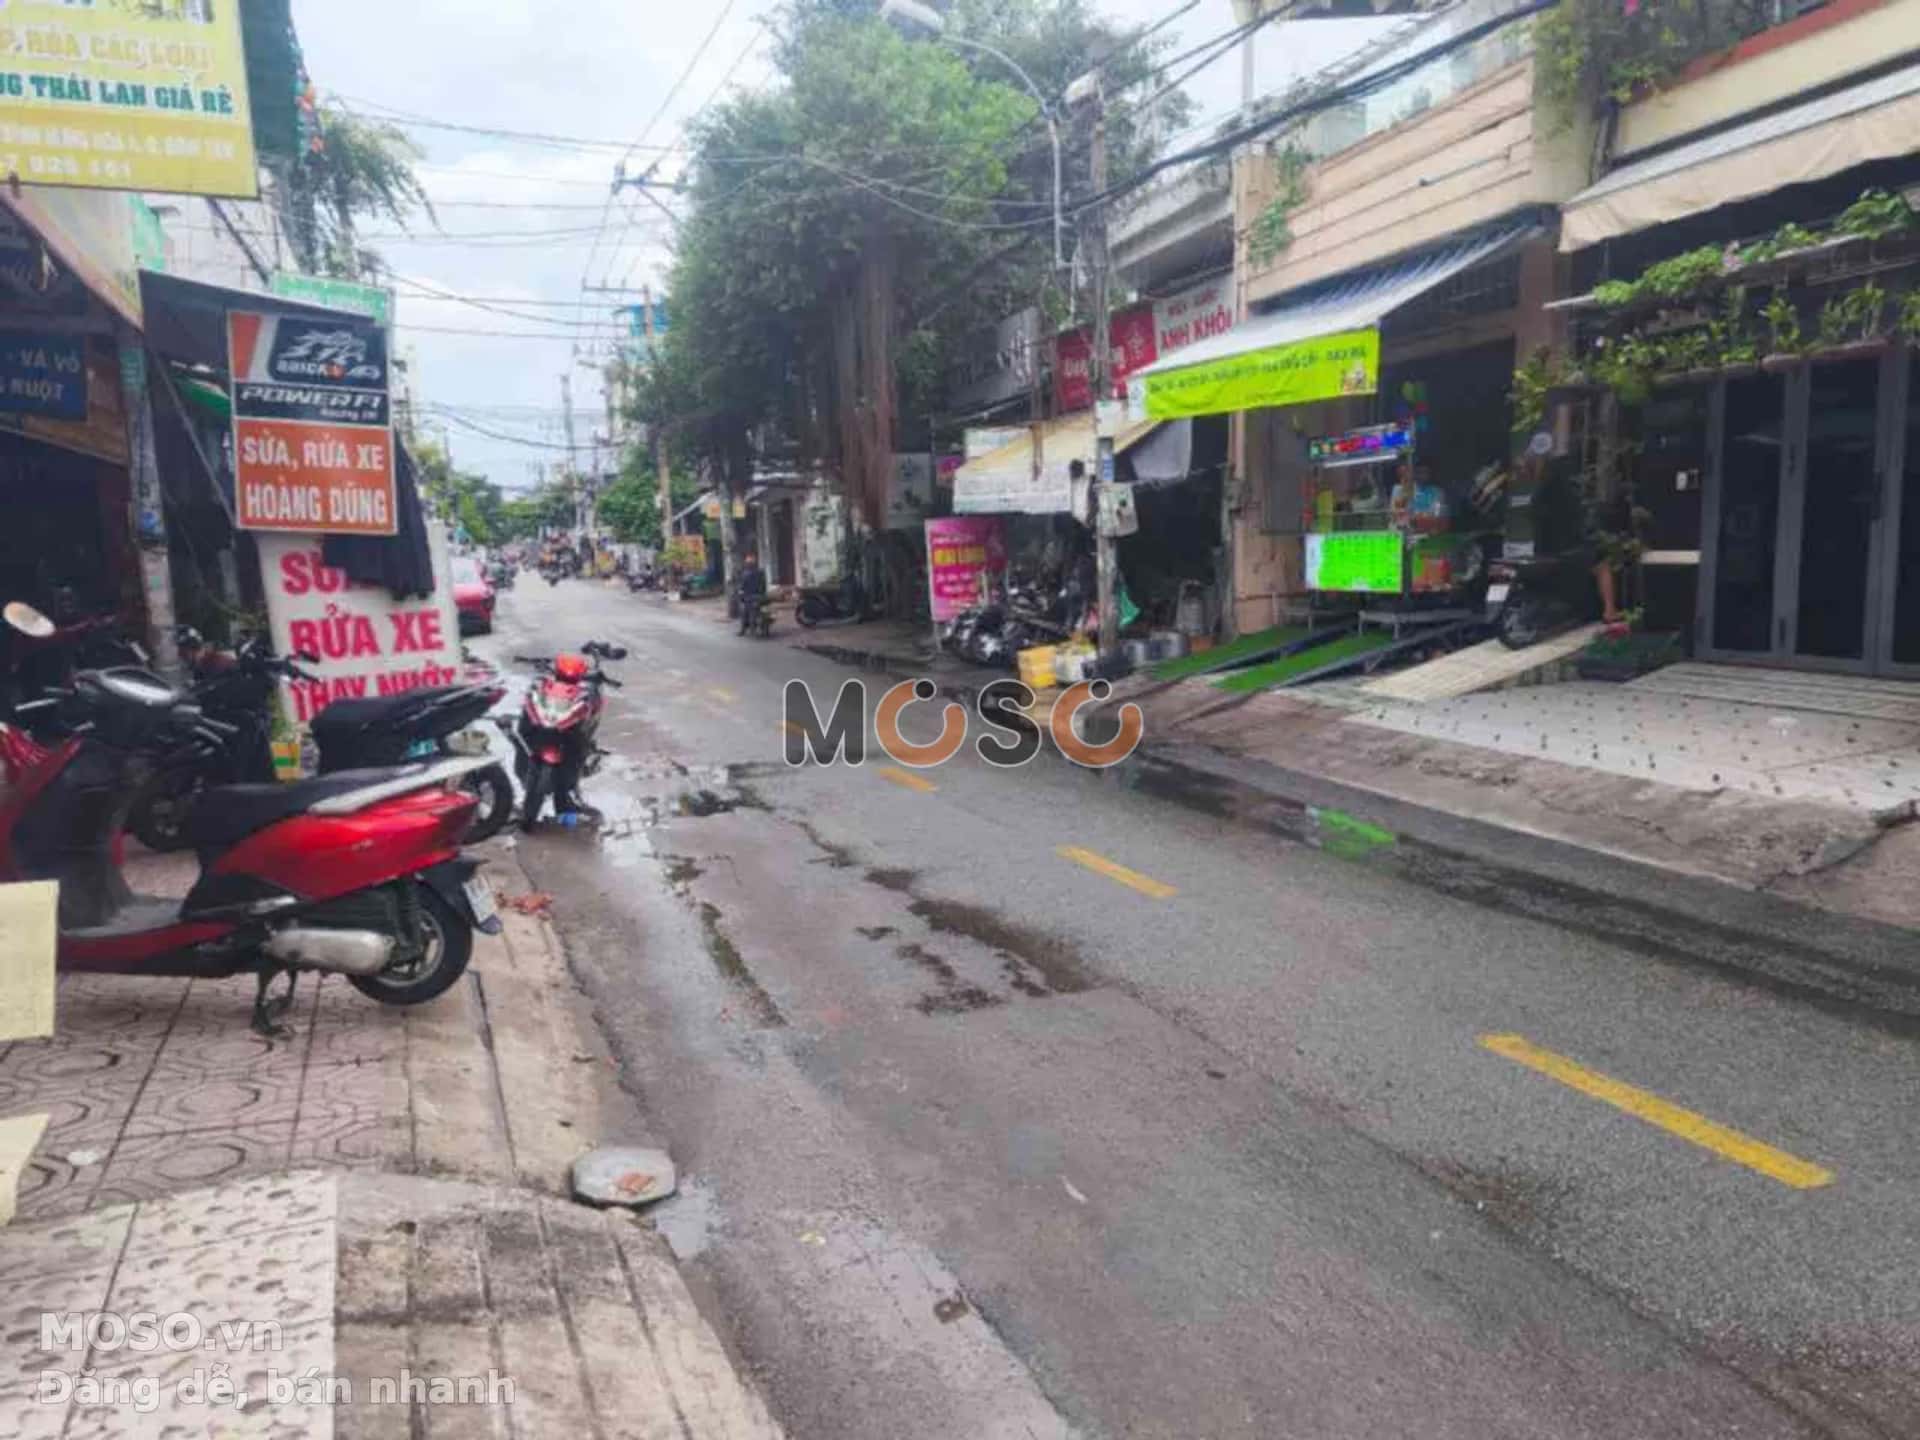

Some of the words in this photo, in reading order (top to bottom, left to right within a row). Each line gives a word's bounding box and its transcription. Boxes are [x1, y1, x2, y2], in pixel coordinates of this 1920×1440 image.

[29, 72, 92, 101] THÁI
[99, 80, 146, 106] LAN
[155, 81, 195, 109] GIÁ
[356, 443, 385, 471] XE
[245, 475, 322, 523] HOÀNG
[329, 480, 388, 525] DŨNG
[289, 601, 381, 662] RỬA
[387, 607, 445, 654] XE
